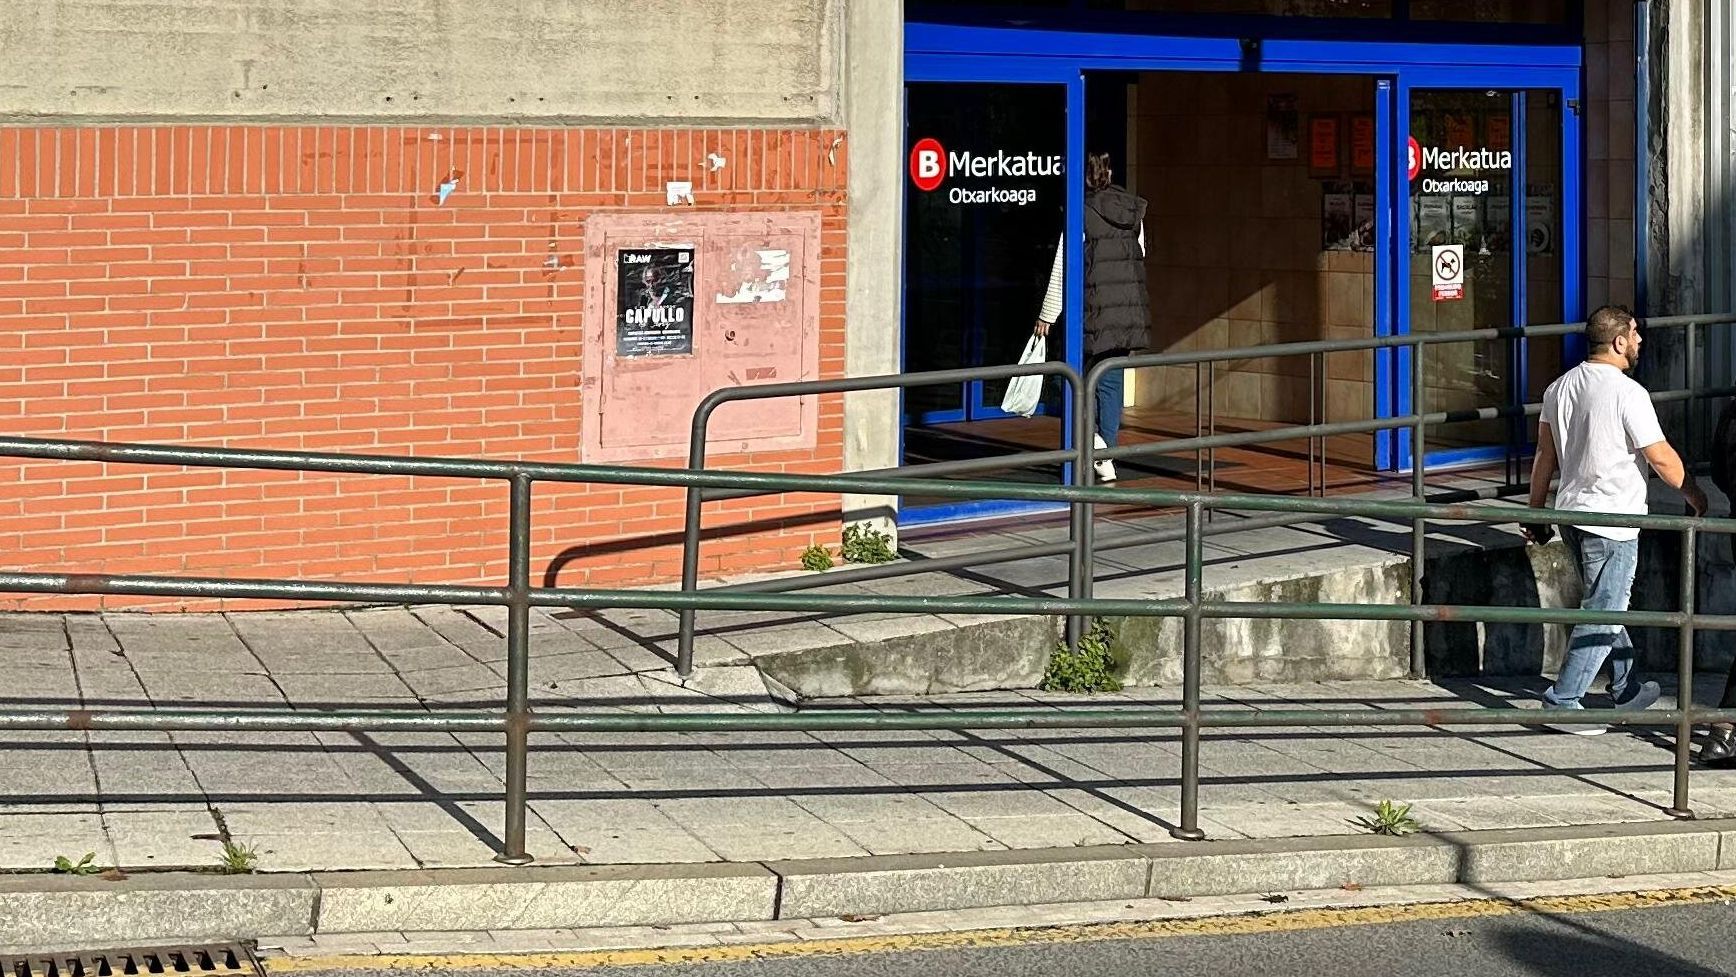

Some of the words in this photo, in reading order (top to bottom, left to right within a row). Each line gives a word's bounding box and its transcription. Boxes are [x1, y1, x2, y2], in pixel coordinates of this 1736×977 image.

[918, 149, 941, 179] B
[949, 149, 1066, 177] Merkatua
[1422, 145, 1512, 170] Merkatua
[949, 186, 1036, 206] Otxarkoaga
[1422, 178, 1489, 195] Otxarkoaga
[625, 307, 685, 324] CAPULLO
